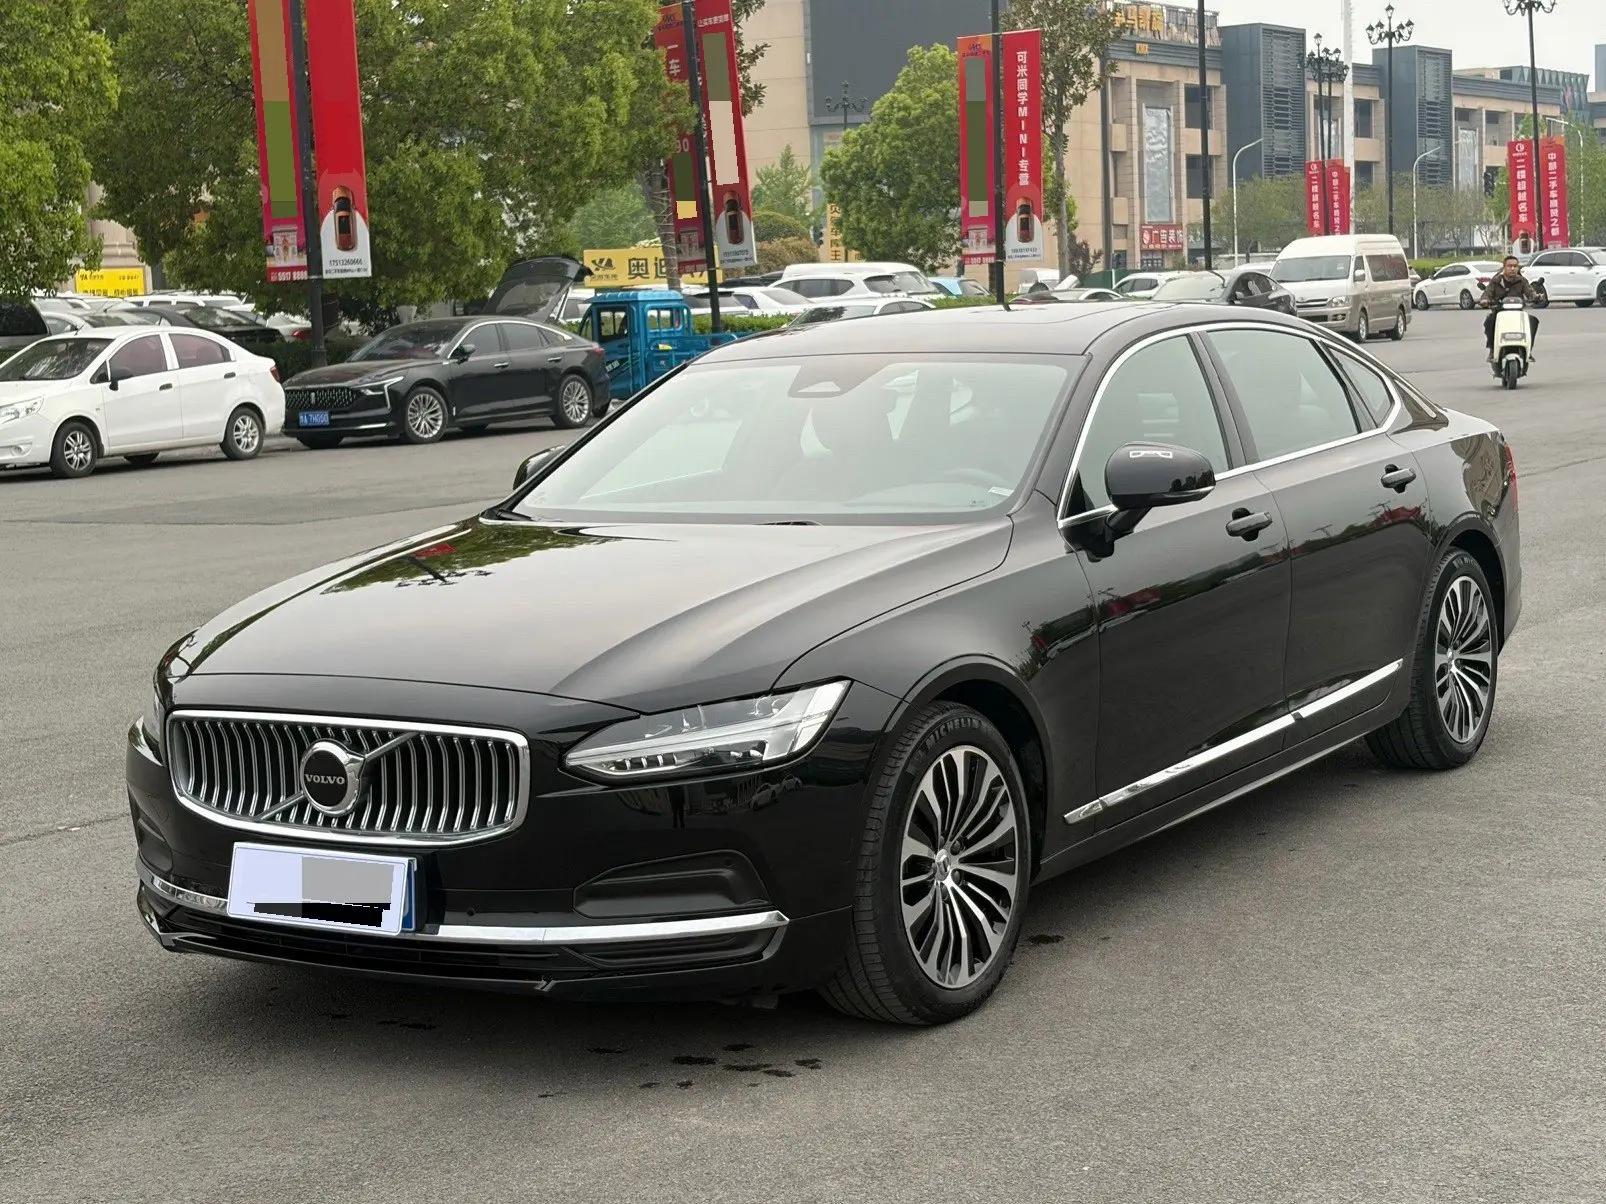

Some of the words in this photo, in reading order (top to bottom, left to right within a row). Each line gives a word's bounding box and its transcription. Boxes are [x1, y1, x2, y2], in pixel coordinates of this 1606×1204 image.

[1016, 51, 1029, 186] 可米同学MINI专营
[304, 773, 345, 785] VOLVO
